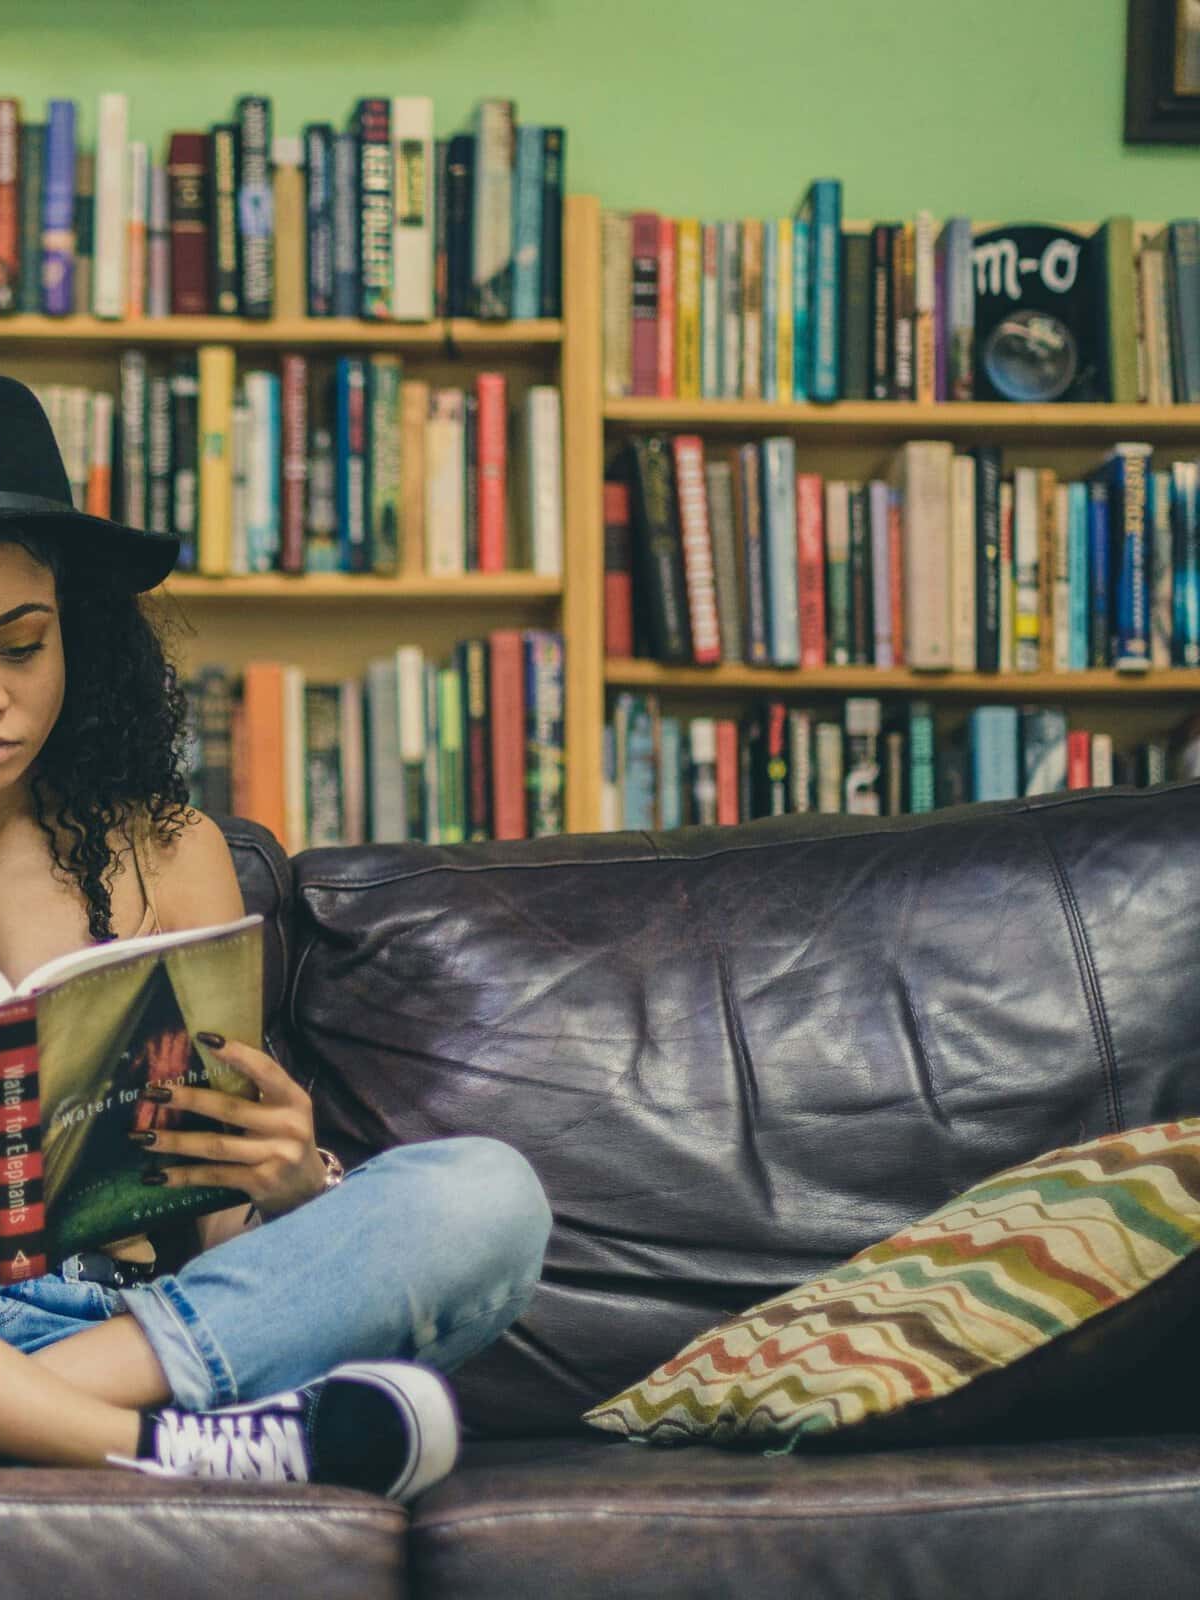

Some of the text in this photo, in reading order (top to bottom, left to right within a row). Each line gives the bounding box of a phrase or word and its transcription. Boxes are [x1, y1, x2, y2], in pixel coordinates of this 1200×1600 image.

[3, 1063, 29, 1224] Water for Elephants
[61, 1097, 112, 1129] Water
[119, 1088, 140, 1105] for
